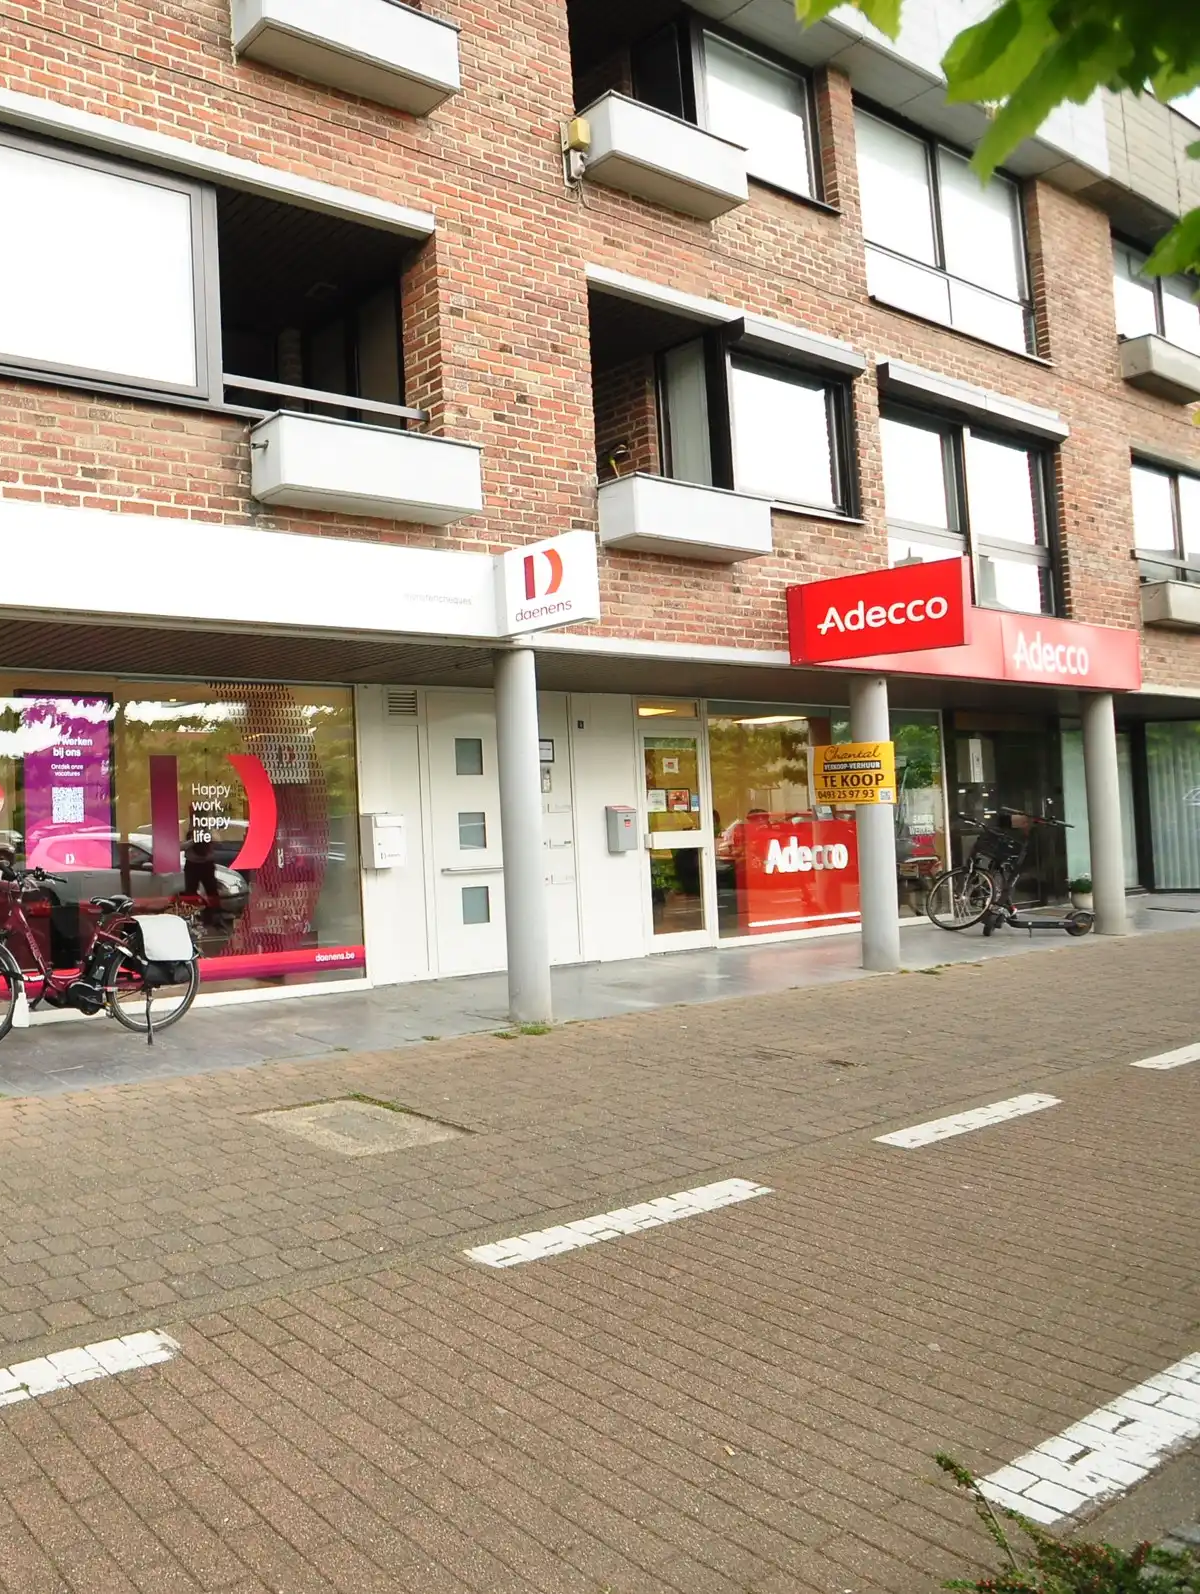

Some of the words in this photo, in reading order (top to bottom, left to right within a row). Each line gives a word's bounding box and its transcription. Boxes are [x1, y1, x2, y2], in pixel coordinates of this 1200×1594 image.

[515, 600, 573, 622] daenens
[816, 596, 949, 635] Adecco
[1012, 629, 1090, 676] Adecco
[52, 747, 65, 758] bij
[65, 749, 82, 757] ons
[824, 744, 882, 761] Chantal
[822, 775, 837, 788] TE
[841, 773, 885, 788] KOOP
[191, 783, 231, 798] Happy
[818, 790, 835, 799] 0493
[838, 789, 847, 798] 25
[849, 789, 860, 798] 97
[863, 789, 875, 798] 93
[191, 798, 224, 812] work,
[192, 814, 231, 830] happy
[193, 830, 212, 843] life
[763, 835, 849, 874] Adecco
[315, 951, 356, 962] daenens.be
